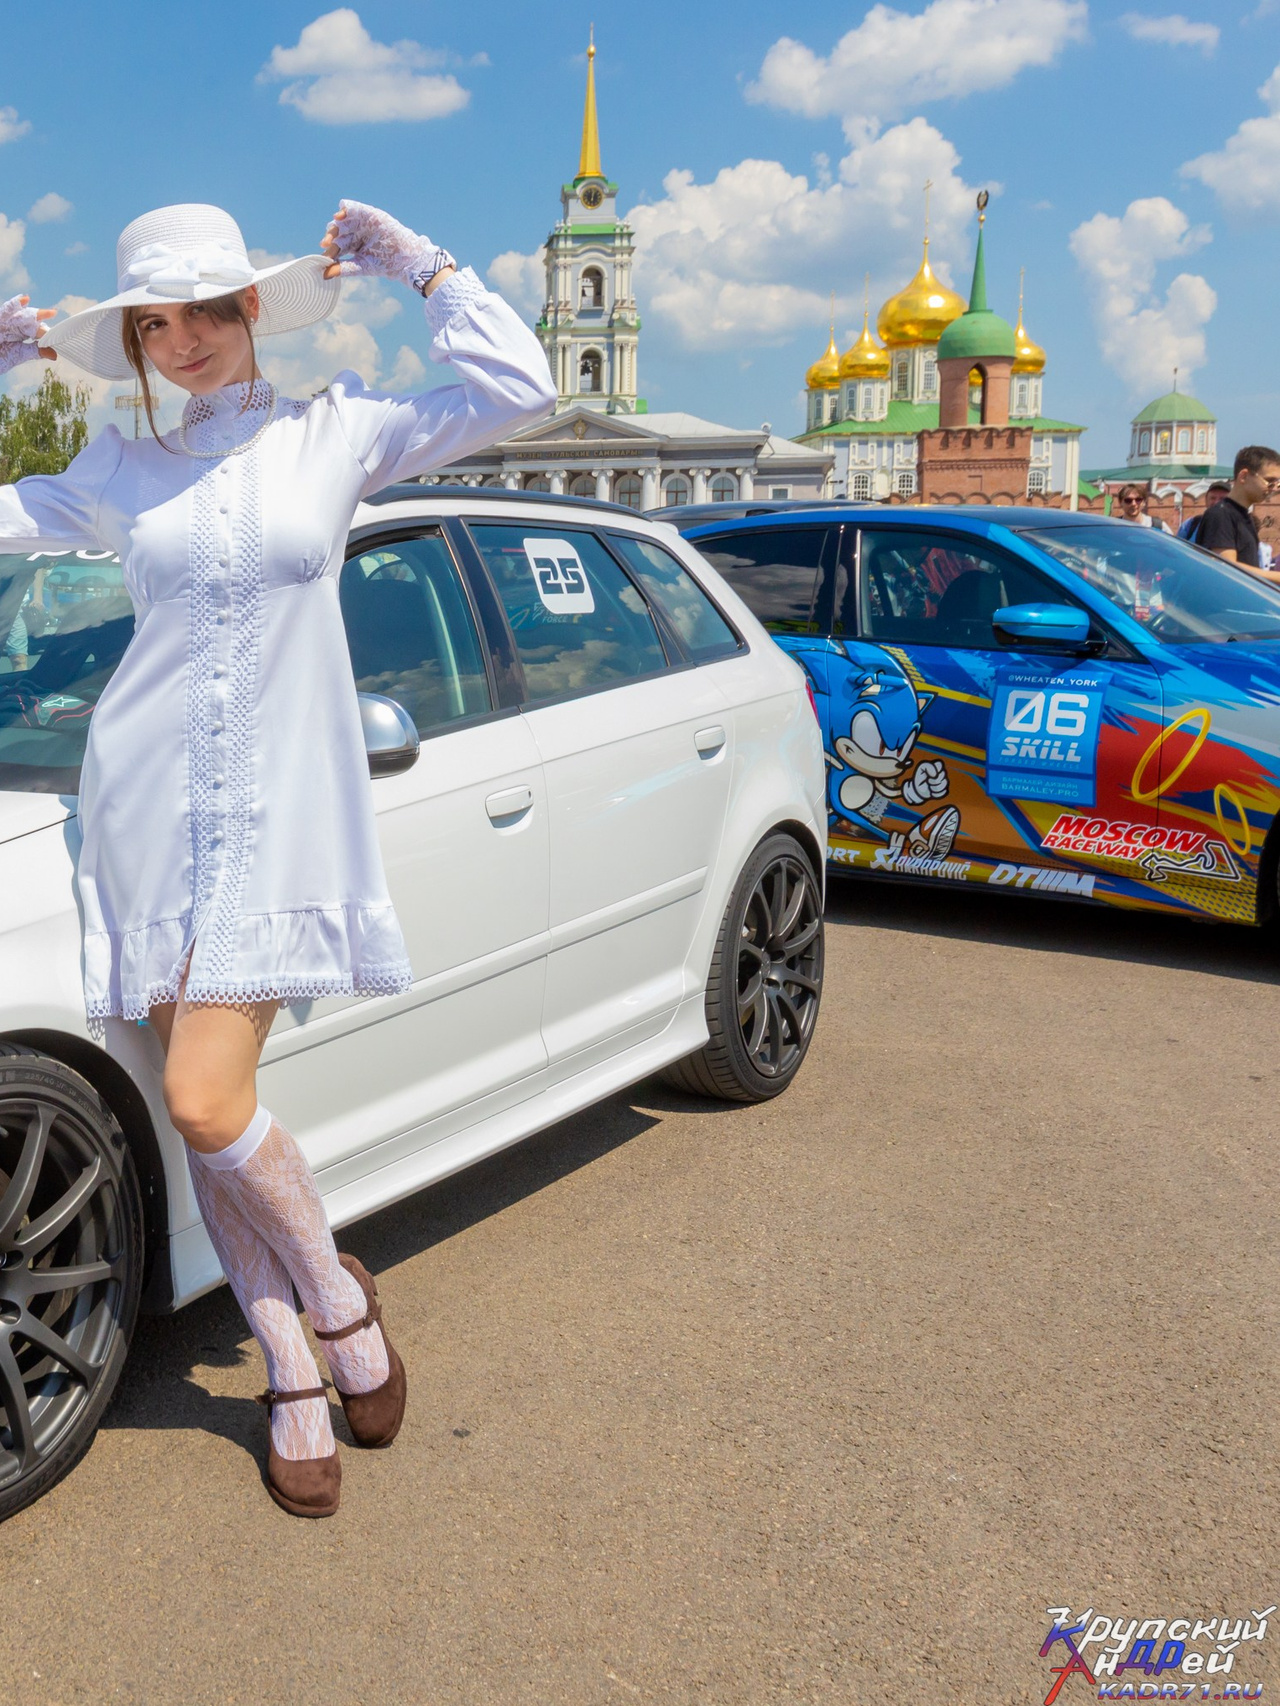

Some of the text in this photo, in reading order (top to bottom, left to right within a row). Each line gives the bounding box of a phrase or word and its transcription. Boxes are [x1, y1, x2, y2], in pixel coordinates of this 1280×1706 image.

[533, 557, 585, 595] 25
[1008, 675, 1098, 687] @WHEATEN_YORK
[1004, 690, 1089, 736] 06
[1001, 736, 1081, 762] SKILL
[1001, 783, 1079, 797] BARMALEY.PRO
[1041, 834, 1147, 860] RACEWAY
[1051, 814, 1205, 854] MOSCOW
